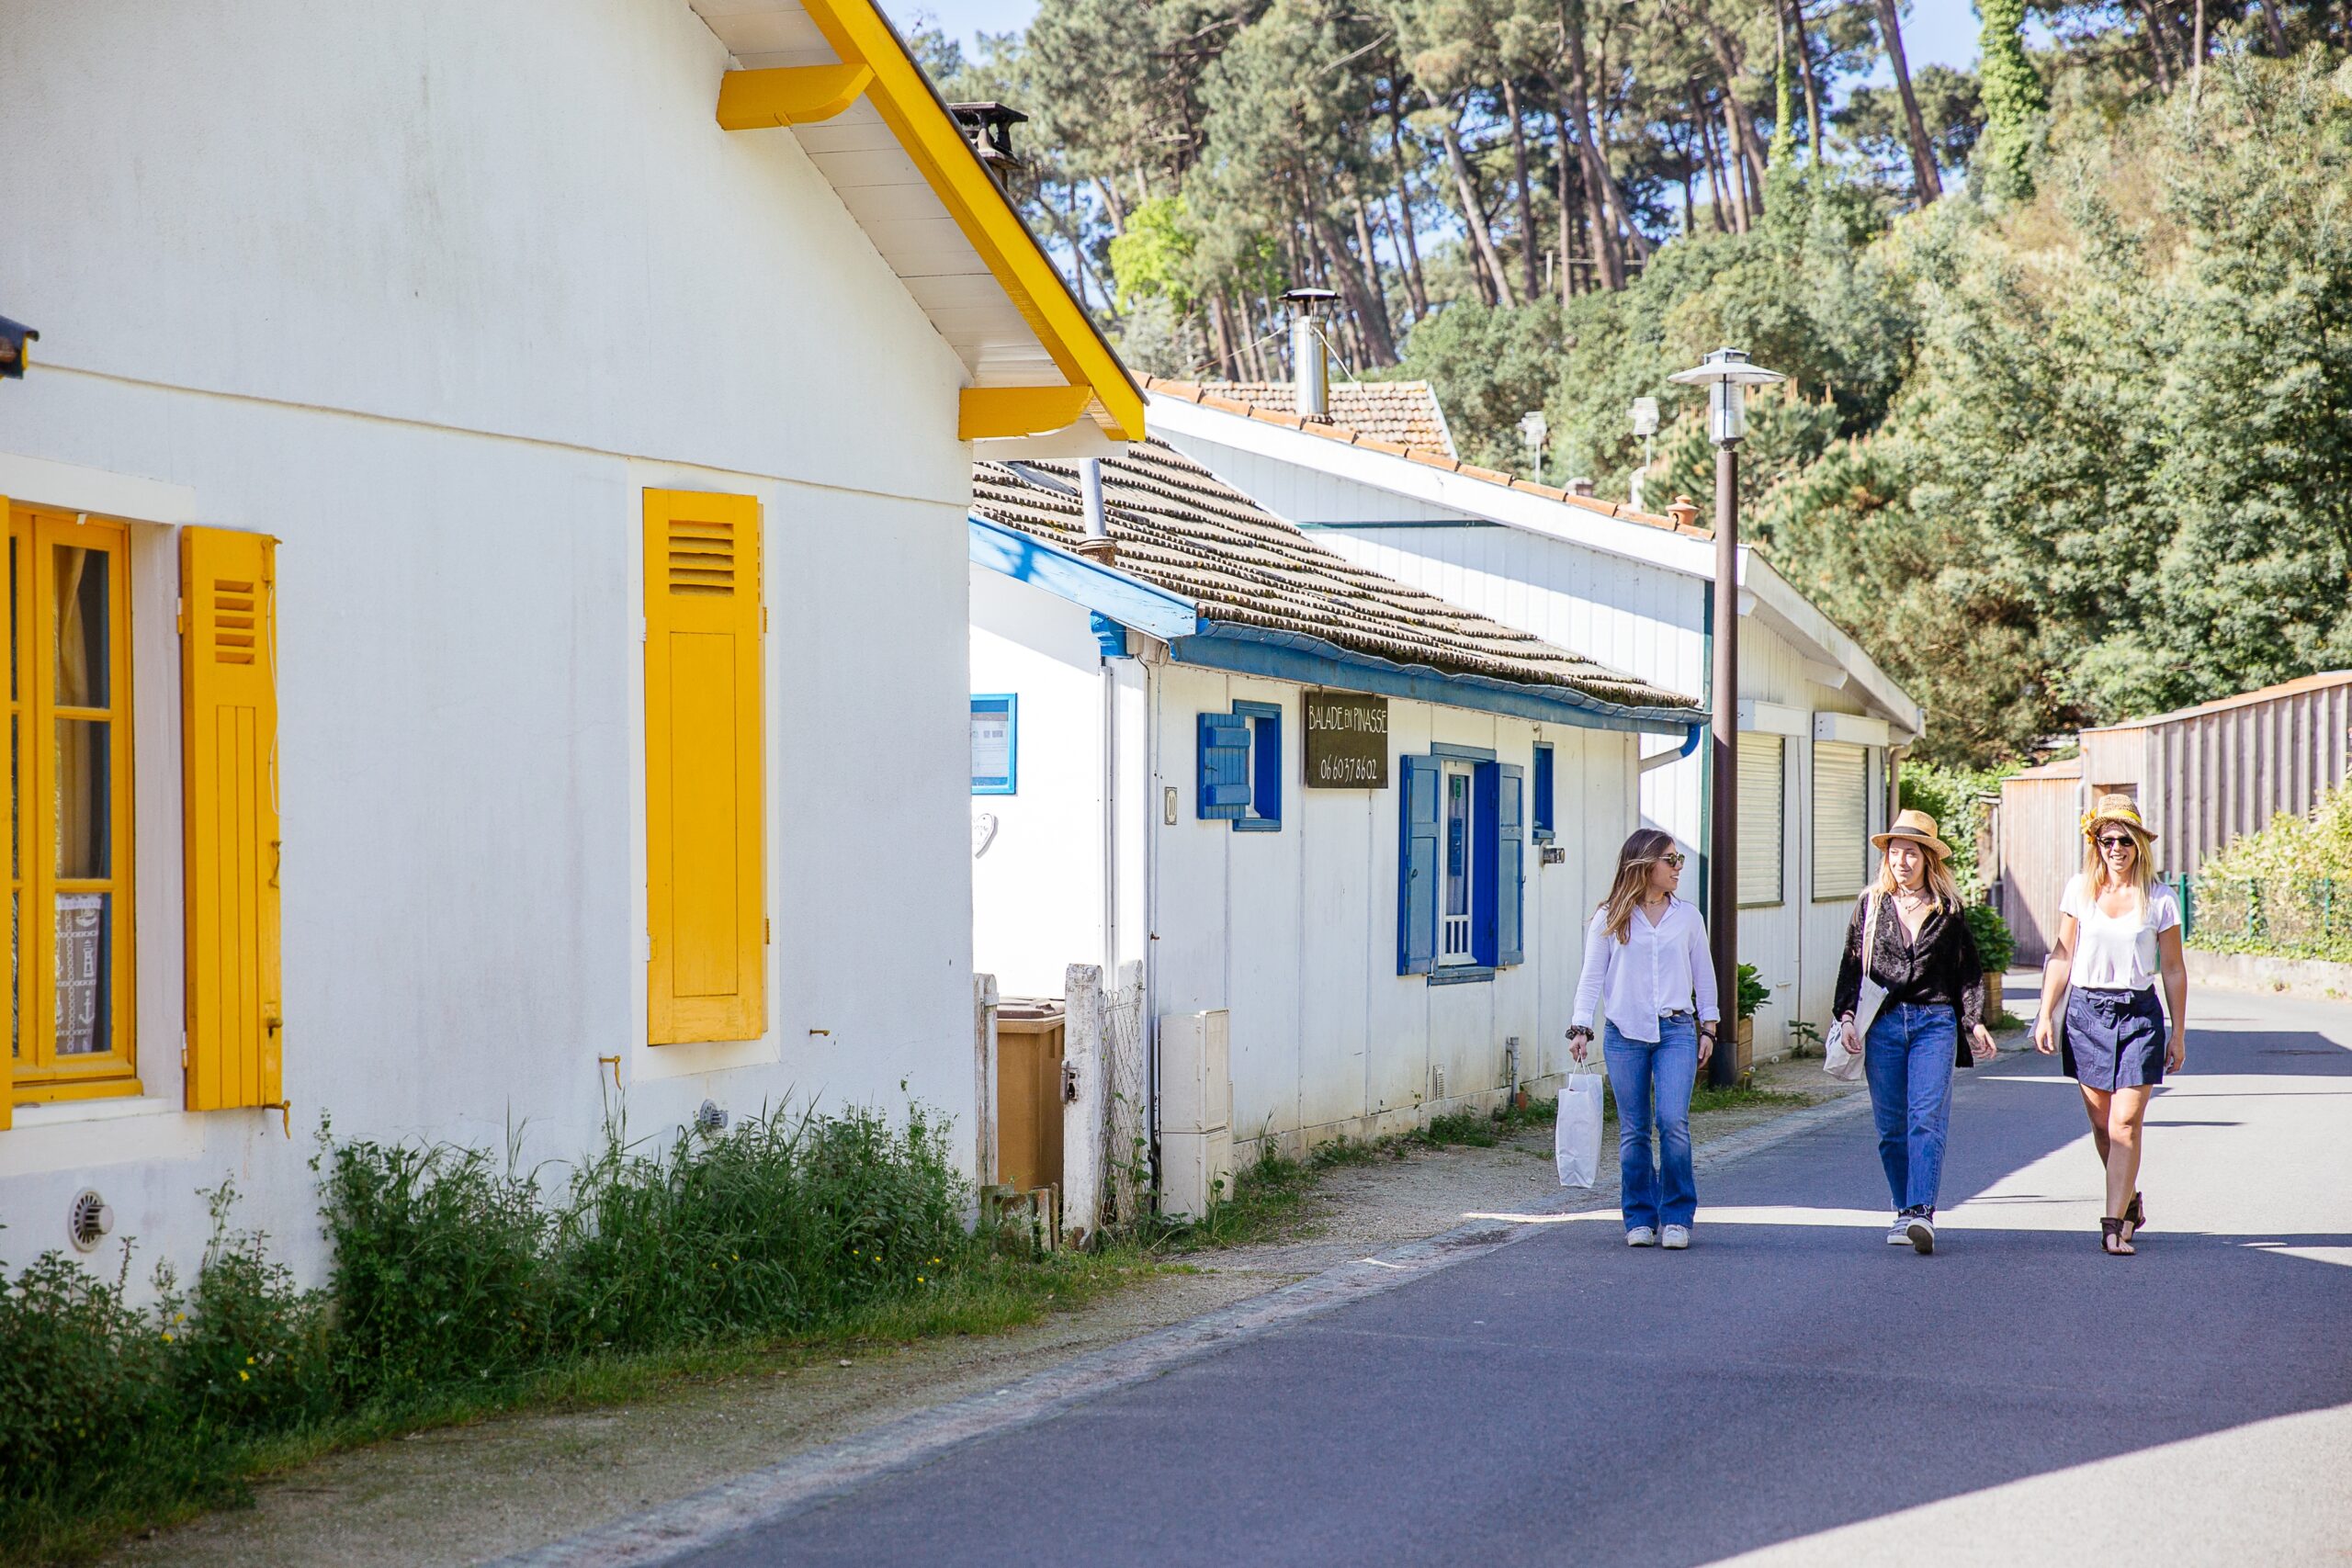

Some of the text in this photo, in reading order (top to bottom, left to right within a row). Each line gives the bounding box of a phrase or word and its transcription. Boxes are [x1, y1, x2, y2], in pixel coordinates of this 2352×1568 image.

[1308, 705, 1388, 734] BALADE EN PINASSE
[1169, 795, 1176, 817] 10
